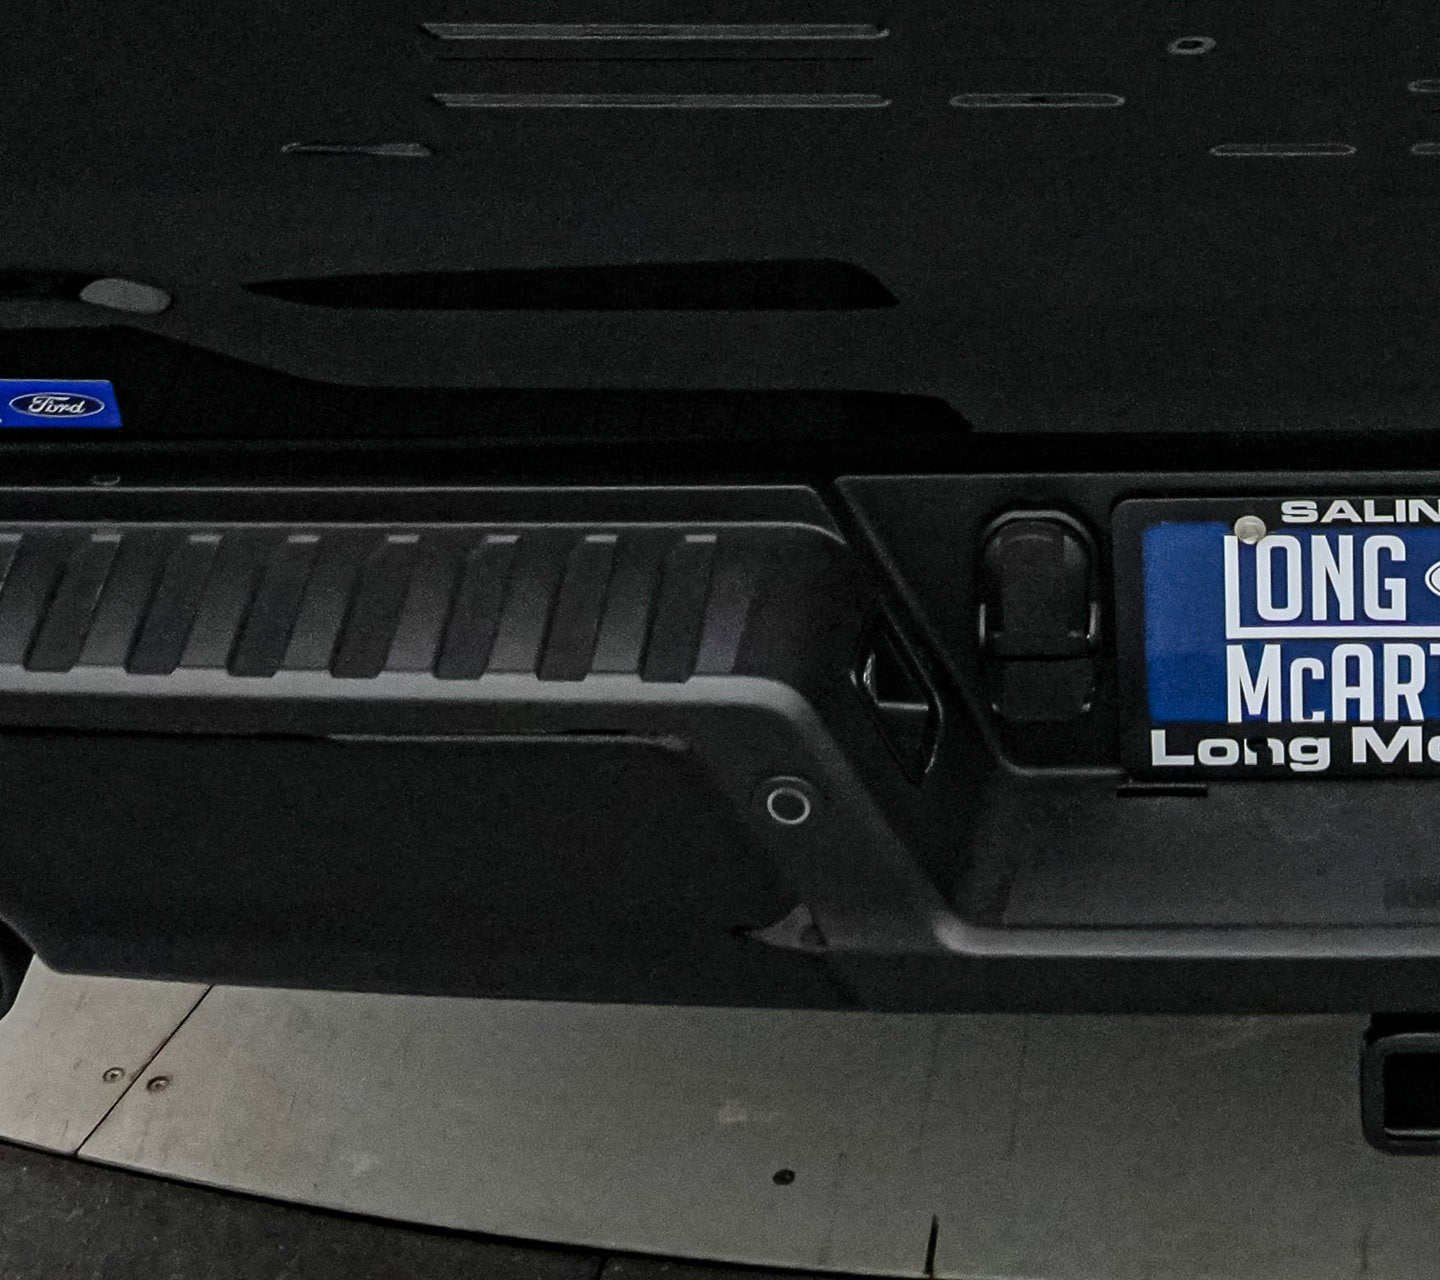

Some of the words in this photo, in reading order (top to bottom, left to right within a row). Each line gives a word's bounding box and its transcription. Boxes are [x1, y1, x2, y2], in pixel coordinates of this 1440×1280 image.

[27, 395, 86, 414] Ford
[1223, 534, 1408, 640] LONG
[1150, 728, 1331, 772] Long
